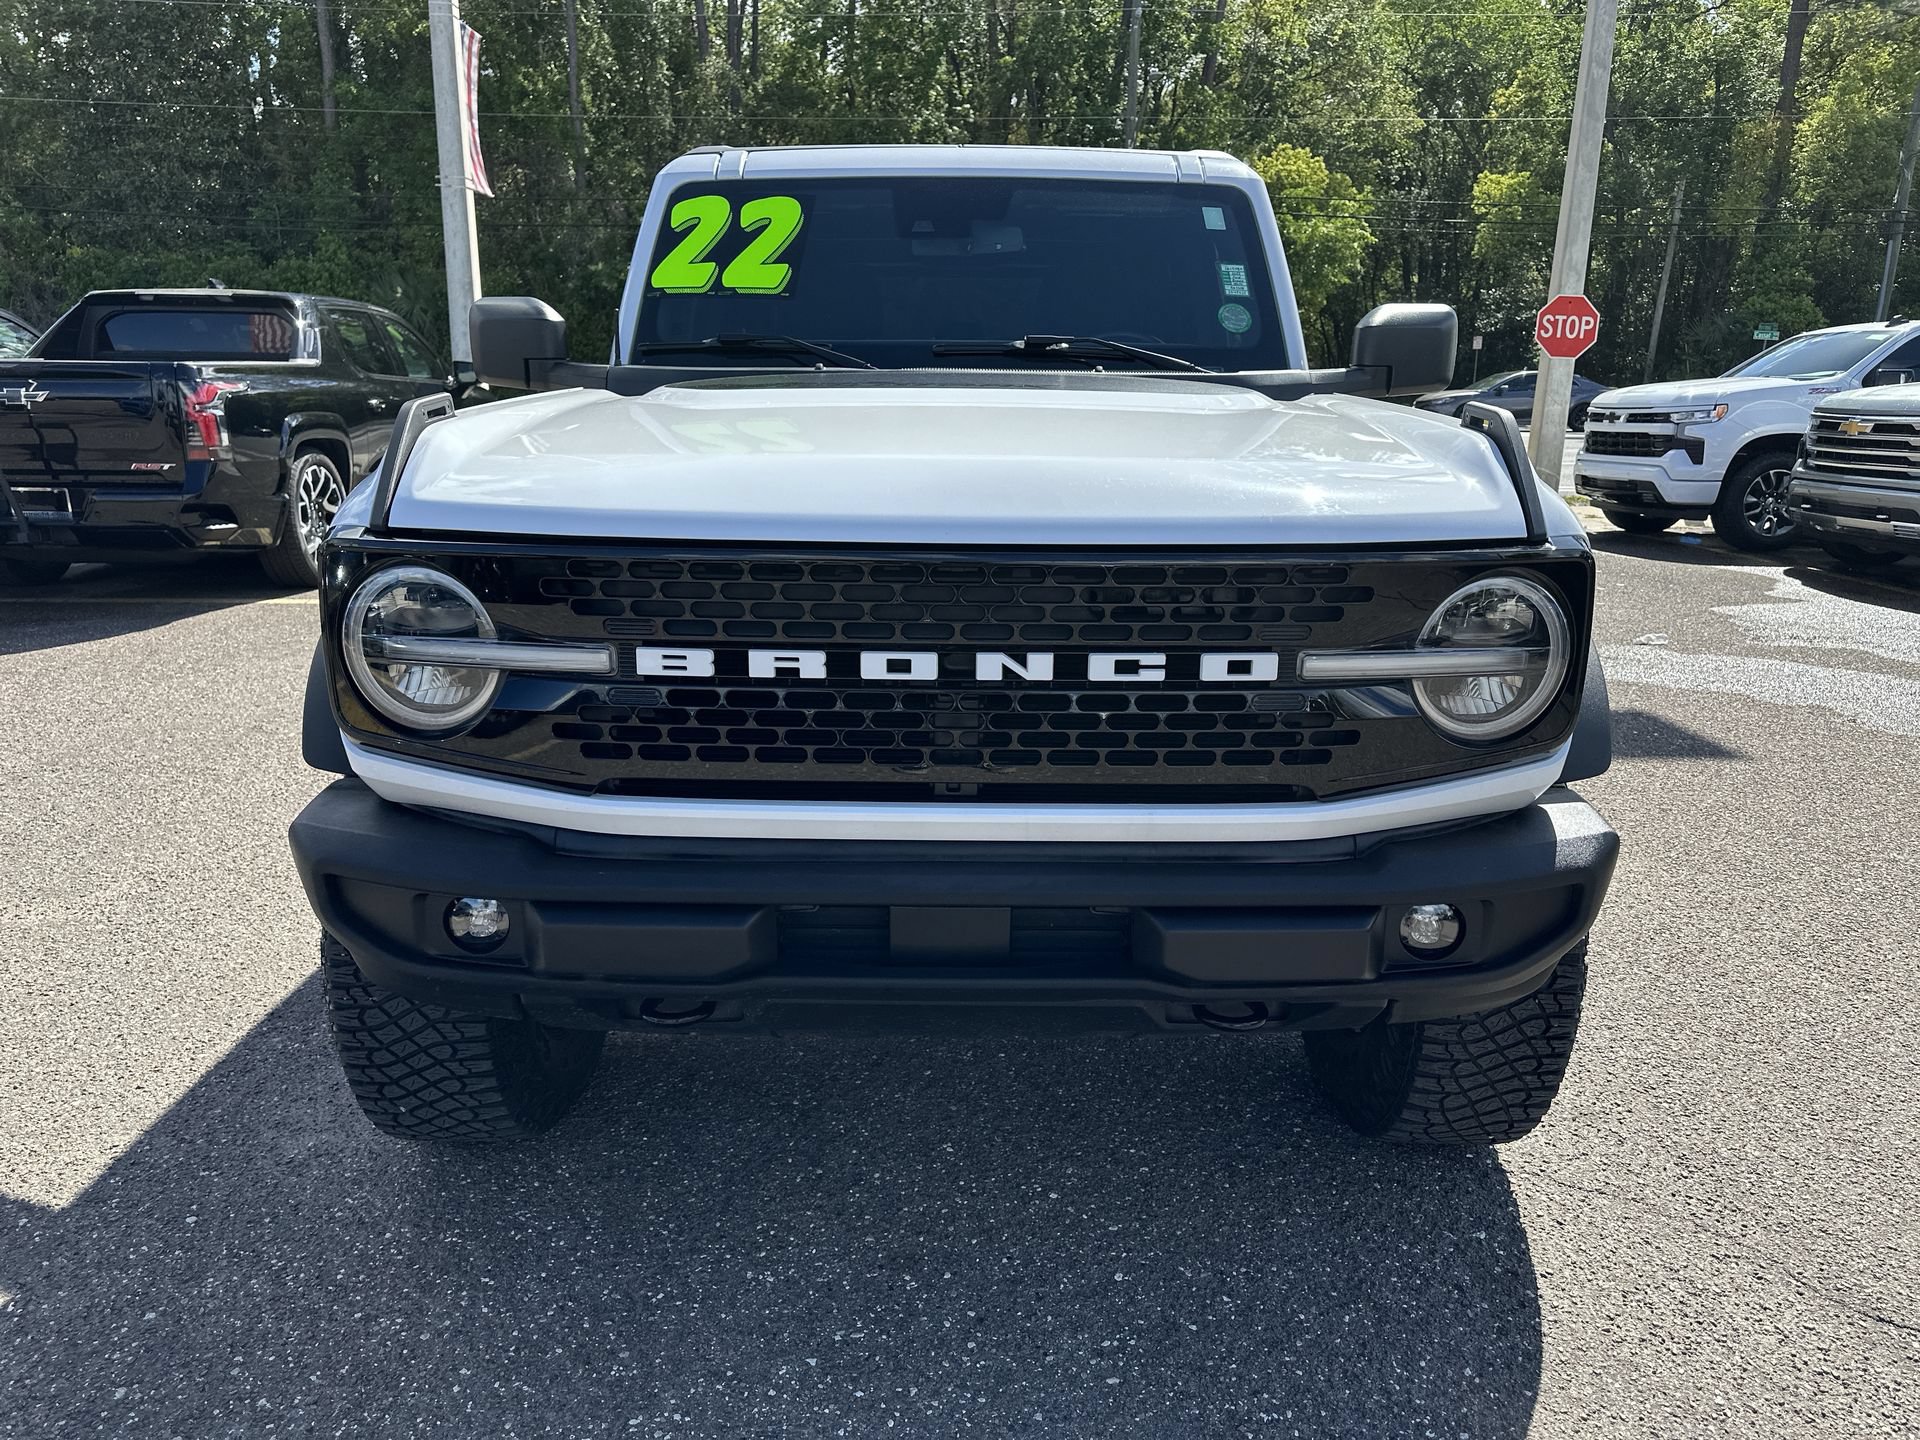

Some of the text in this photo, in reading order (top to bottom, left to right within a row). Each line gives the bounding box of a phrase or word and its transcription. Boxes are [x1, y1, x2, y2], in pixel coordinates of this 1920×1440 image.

[651, 195, 804, 295] 22
[1540, 314, 1595, 339] STOP
[636, 647, 1278, 682] BRONCO
